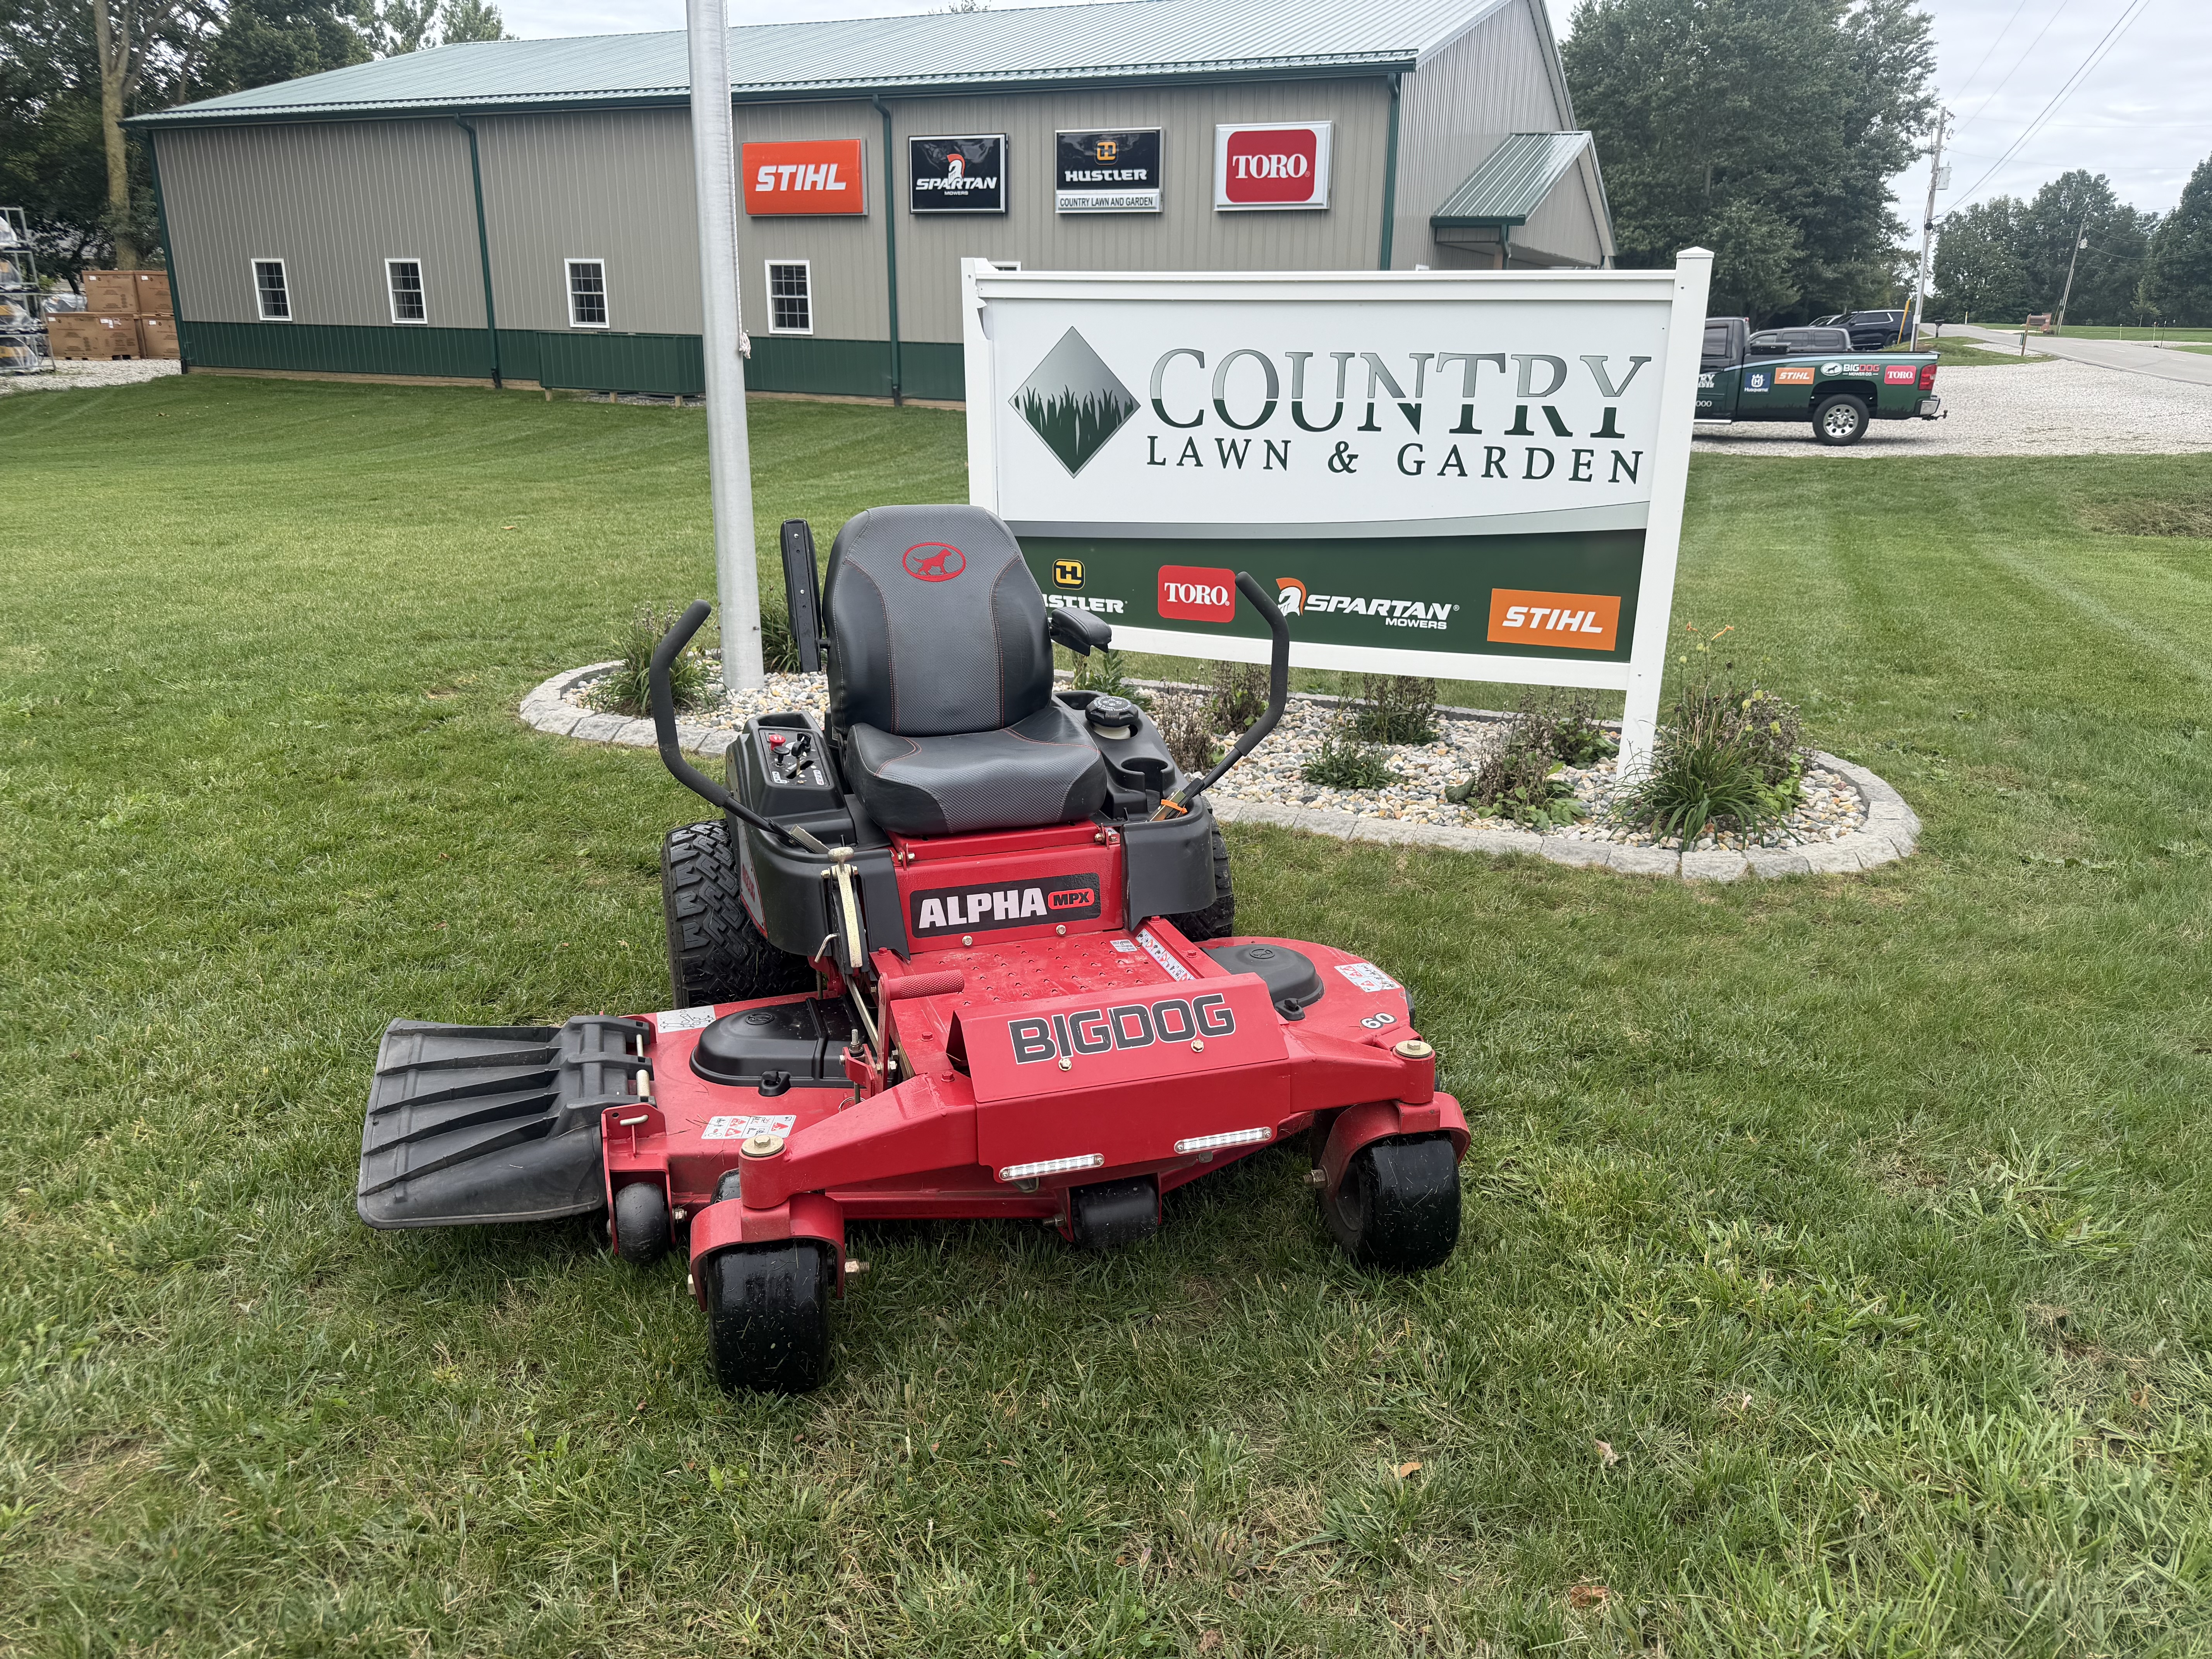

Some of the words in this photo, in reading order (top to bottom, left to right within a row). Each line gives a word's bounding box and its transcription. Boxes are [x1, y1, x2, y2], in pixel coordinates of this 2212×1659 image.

[755, 163, 847, 192] STIHL
[1065, 169, 1147, 182] HUSTLER
[1232, 153, 1308, 179] TORO
[915, 177, 998, 190] SPARTAN
[1060, 198, 1090, 207] COUNTRY
[1091, 198, 1109, 206] LAWN
[1111, 197, 1124, 206] AND
[1125, 197, 1153, 206] GARDEN
[1779, 372, 1810, 380] STIHL
[1887, 371, 1913, 379] TORO
[1150, 348, 1652, 439] COUNTRY
[1147, 436, 1291, 471] LAWN
[1328, 441, 1359, 474] &
[1397, 443, 1644, 485] GARDEN
[1164, 582, 1229, 606] TORO
[1304, 594, 1452, 620] SPARTAN
[1385, 617, 1447, 630] MOWERS
[1501, 606, 1603, 634] STIHL
[919, 888, 1048, 929] ALPHA
[1053, 891, 1091, 907] MPX
[1007, 993, 1236, 1065] BIGDOG
[1360, 1012, 1397, 1029] 60
